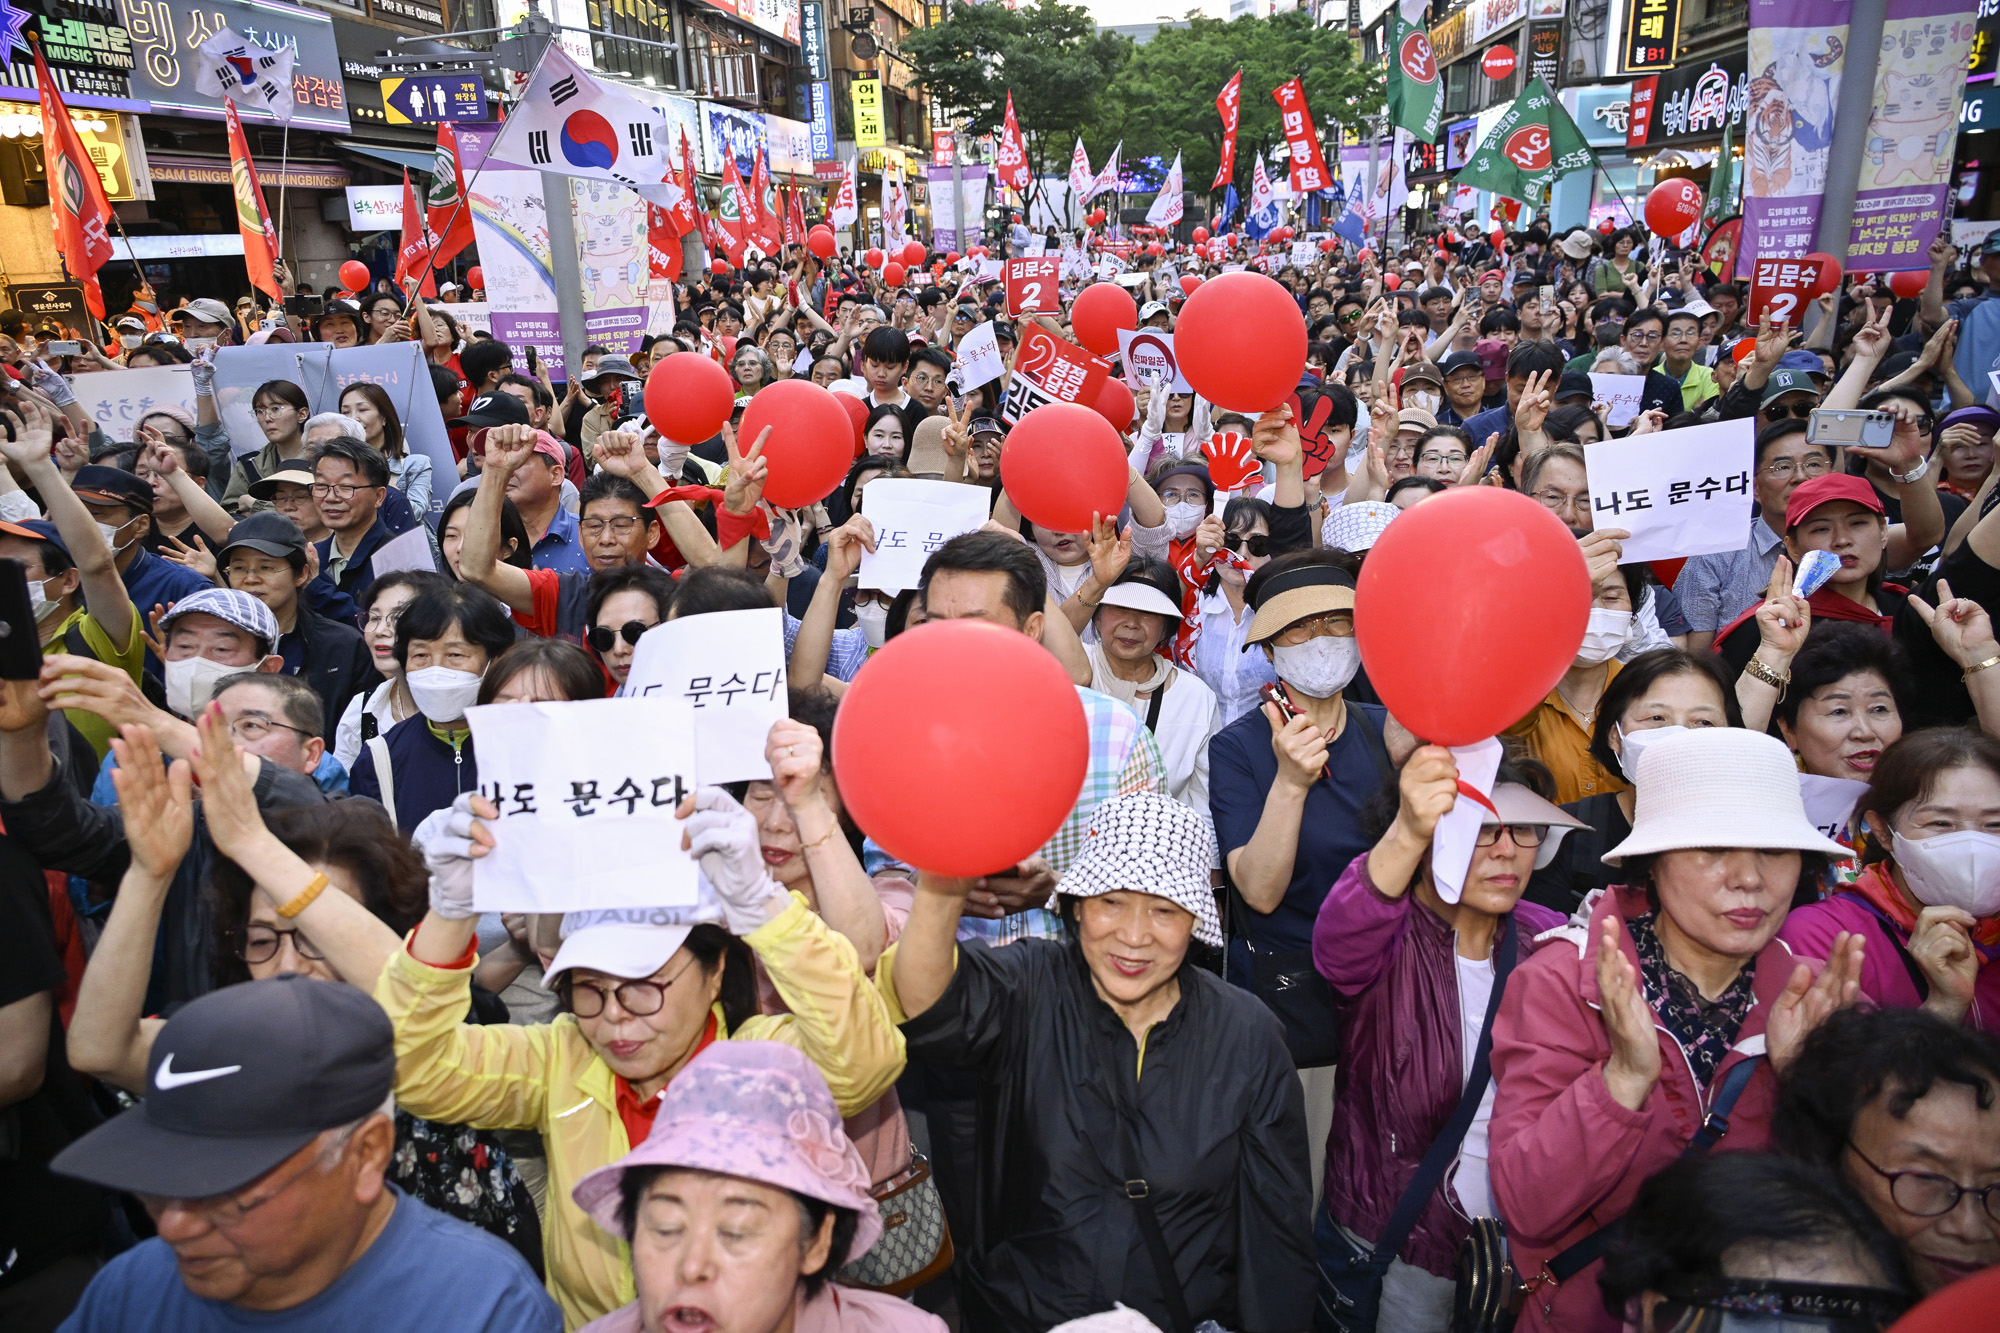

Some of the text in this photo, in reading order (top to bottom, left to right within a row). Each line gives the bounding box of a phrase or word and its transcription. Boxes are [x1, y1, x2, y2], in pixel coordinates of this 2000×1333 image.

[381, 0, 395, 11] POP
[853, 9, 870, 22] 2F
[39, 15, 132, 54] 노래타운
[803, 3, 821, 79] 명륜진사갈비
[46, 45, 135, 69] MUSIC TOWN
[1537, 43, 1553, 52] 식당
[1646, 47, 1666, 61] B1
[111, 82, 122, 92] B1
[293, 74, 344, 110] 삼겹살
[454, 93, 477, 101] 화장실
[461, 83, 475, 92] 개방
[1662, 88, 1691, 136] 범계
[1671, 184, 1702, 207] 6.3
[1106, 255, 1124, 270] 김문수
[1213, 252, 1221, 260] 2
[1273, 256, 1280, 264] 2
[1292, 254, 1314, 263] 김문수
[1012, 261, 1055, 280] 김문수
[1107, 267, 1118, 277] 2
[1258, 263, 1267, 273] 2
[1757, 264, 1818, 288] 김문수
[1019, 282, 1042, 309] 2
[1769, 293, 1799, 322] 2
[970, 341, 998, 362] 문수다
[1022, 334, 1057, 388] 2
[1134, 354, 1166, 367] 진짜일꾼
[1052, 356, 1088, 386] 정정
[1042, 375, 1081, 402] 당당
[1594, 470, 1750, 516] 나도 문수다
[683, 668, 783, 709] 문수다
[563, 775, 691, 818] 문수다
